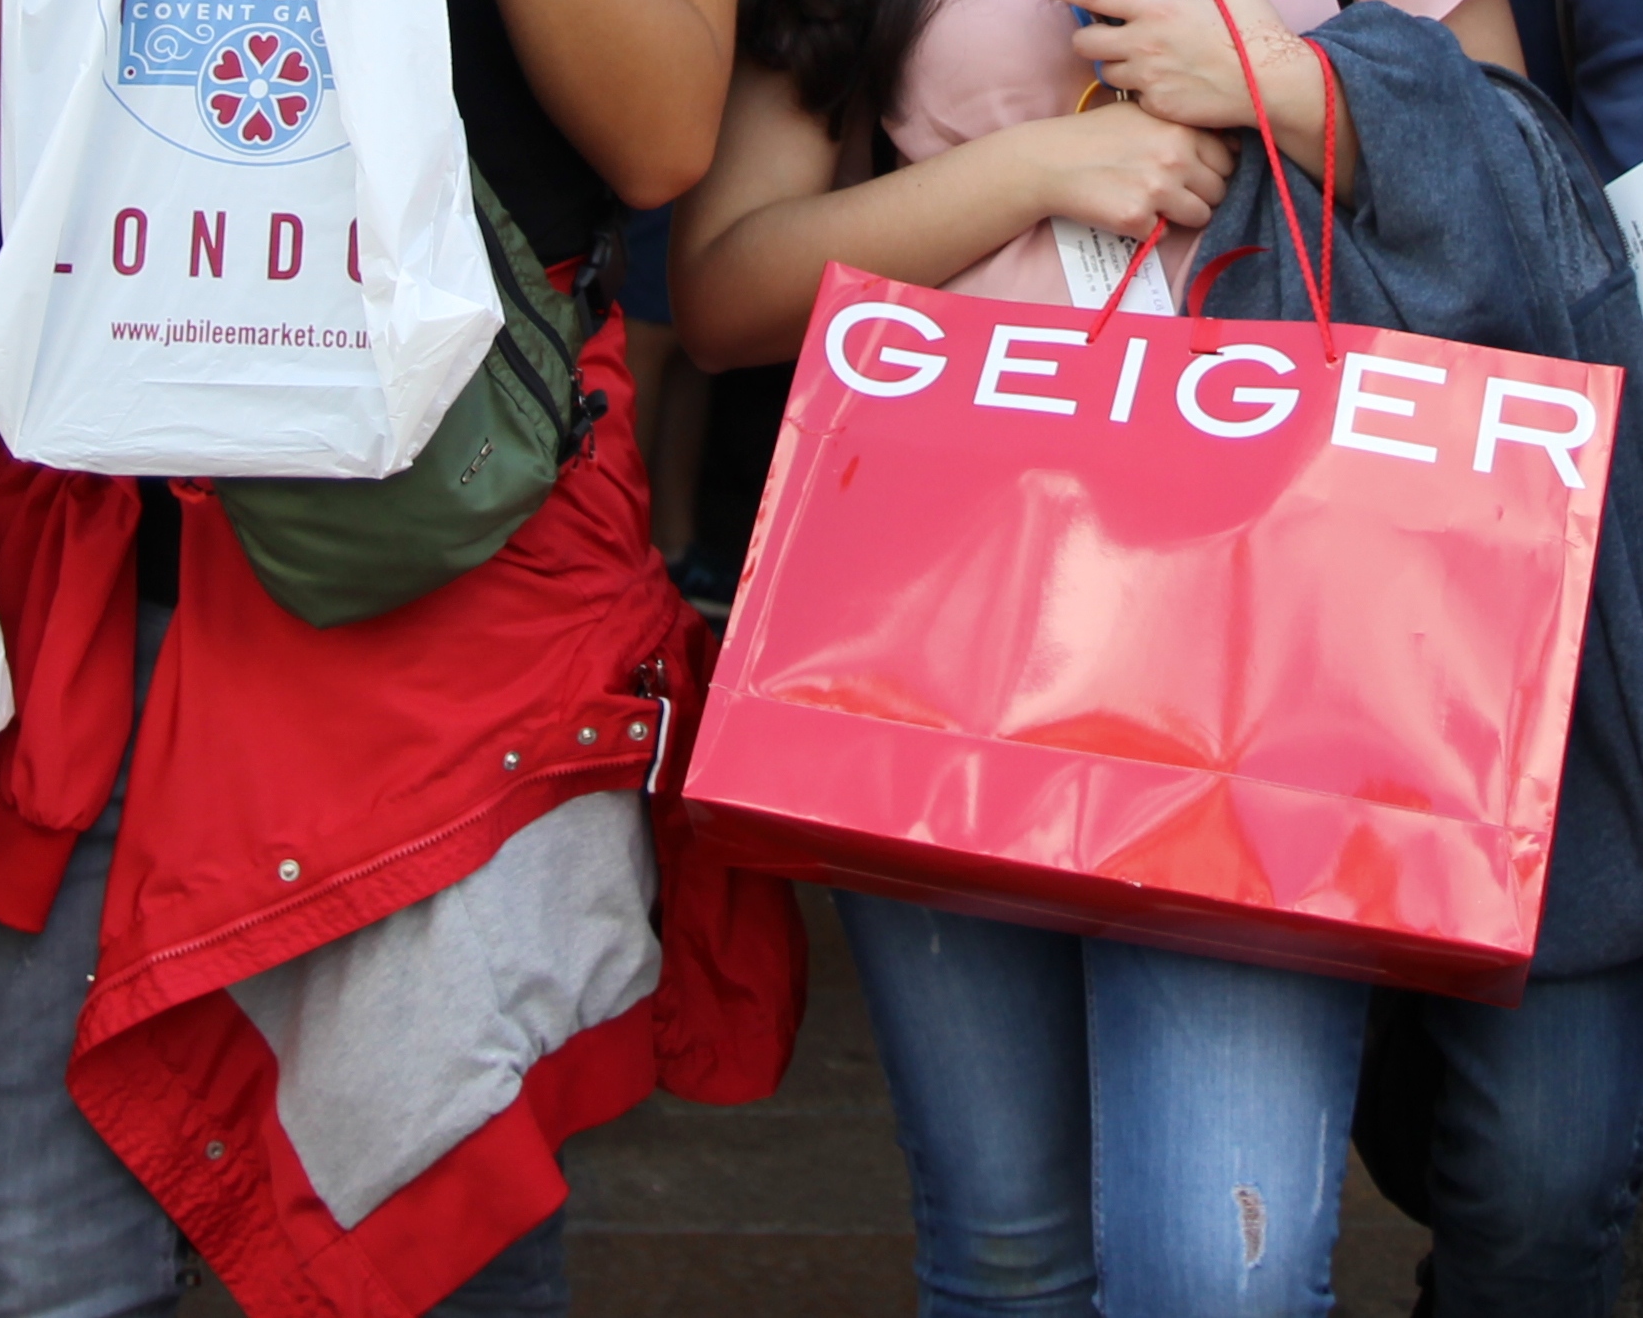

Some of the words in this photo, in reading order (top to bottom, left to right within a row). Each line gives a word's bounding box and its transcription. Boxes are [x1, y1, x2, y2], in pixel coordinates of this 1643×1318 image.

[132, 1, 255, 22] COVENT
[110, 317, 372, 349] www.jubileemarket.co.u
[823, 300, 1598, 490] GEIGER
